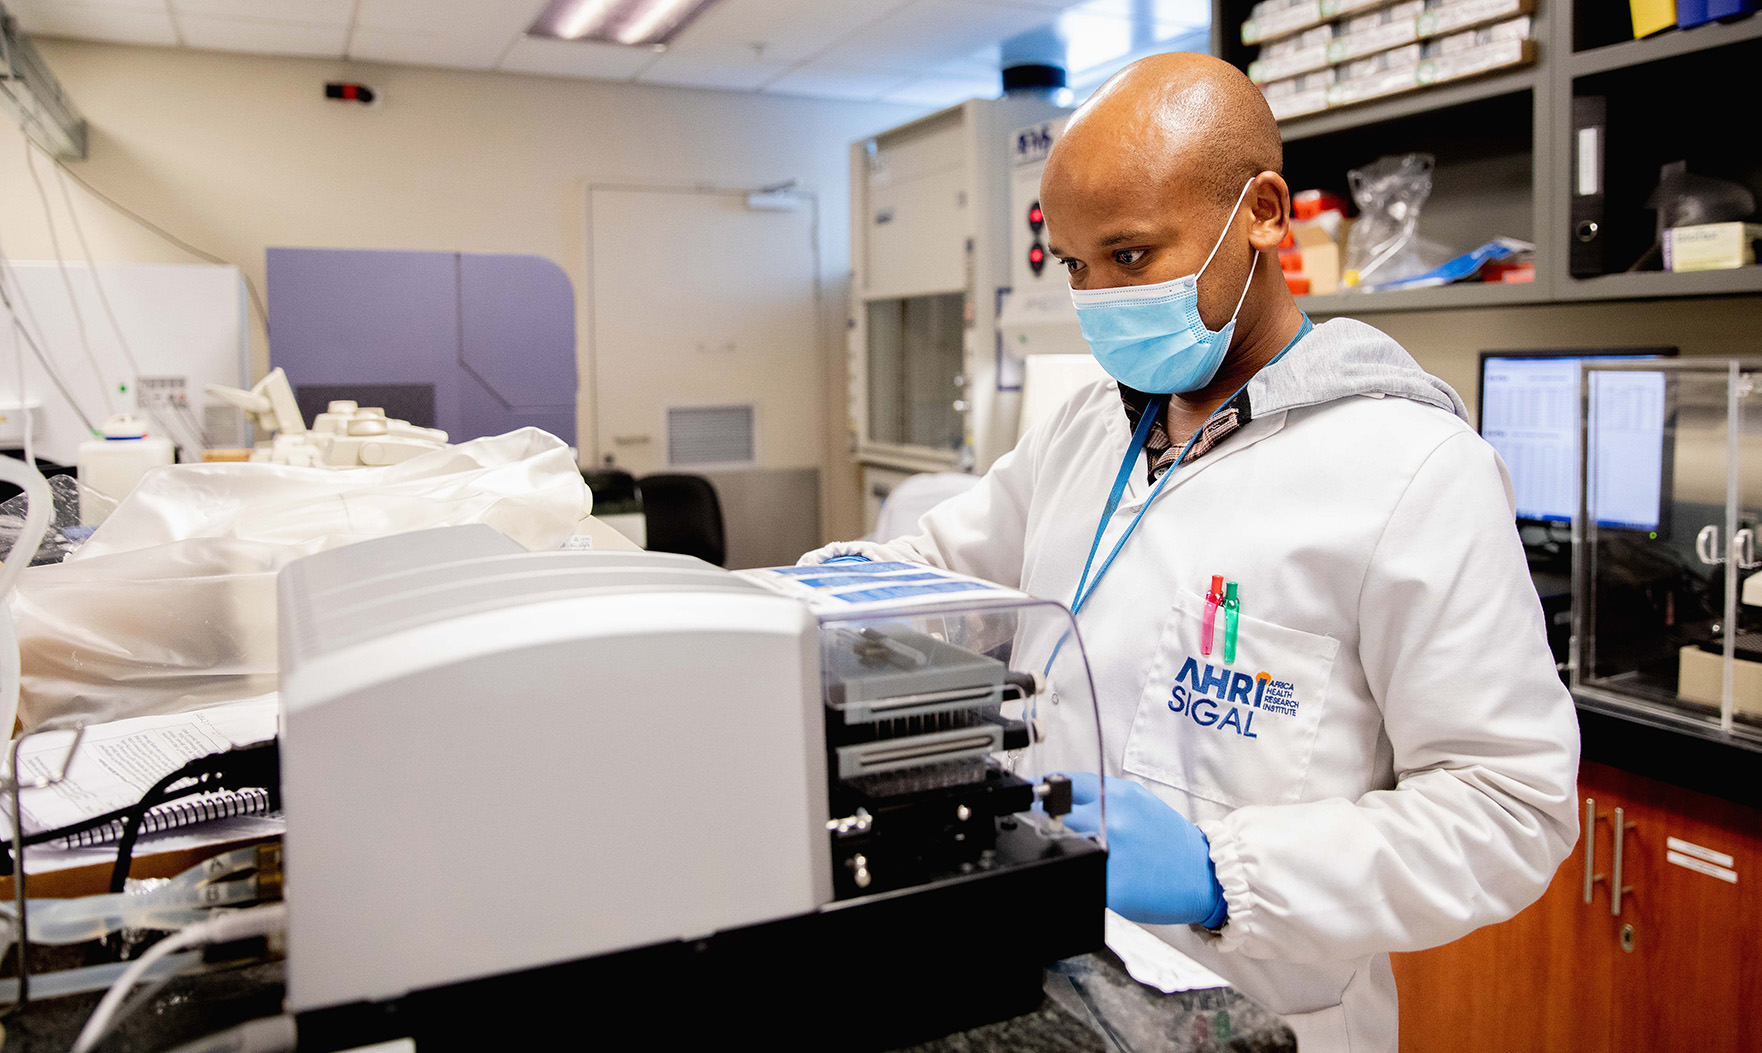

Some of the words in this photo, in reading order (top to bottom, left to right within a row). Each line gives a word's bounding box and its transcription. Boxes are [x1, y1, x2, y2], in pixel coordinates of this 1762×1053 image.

[1269, 680, 1294, 691] AFRICA
[1266, 688, 1293, 699] HEALTH
[1264, 695, 1300, 708] RESEARCH
[1168, 685, 1257, 739] SIGAL
[1262, 703, 1297, 717] INSTITUTE
